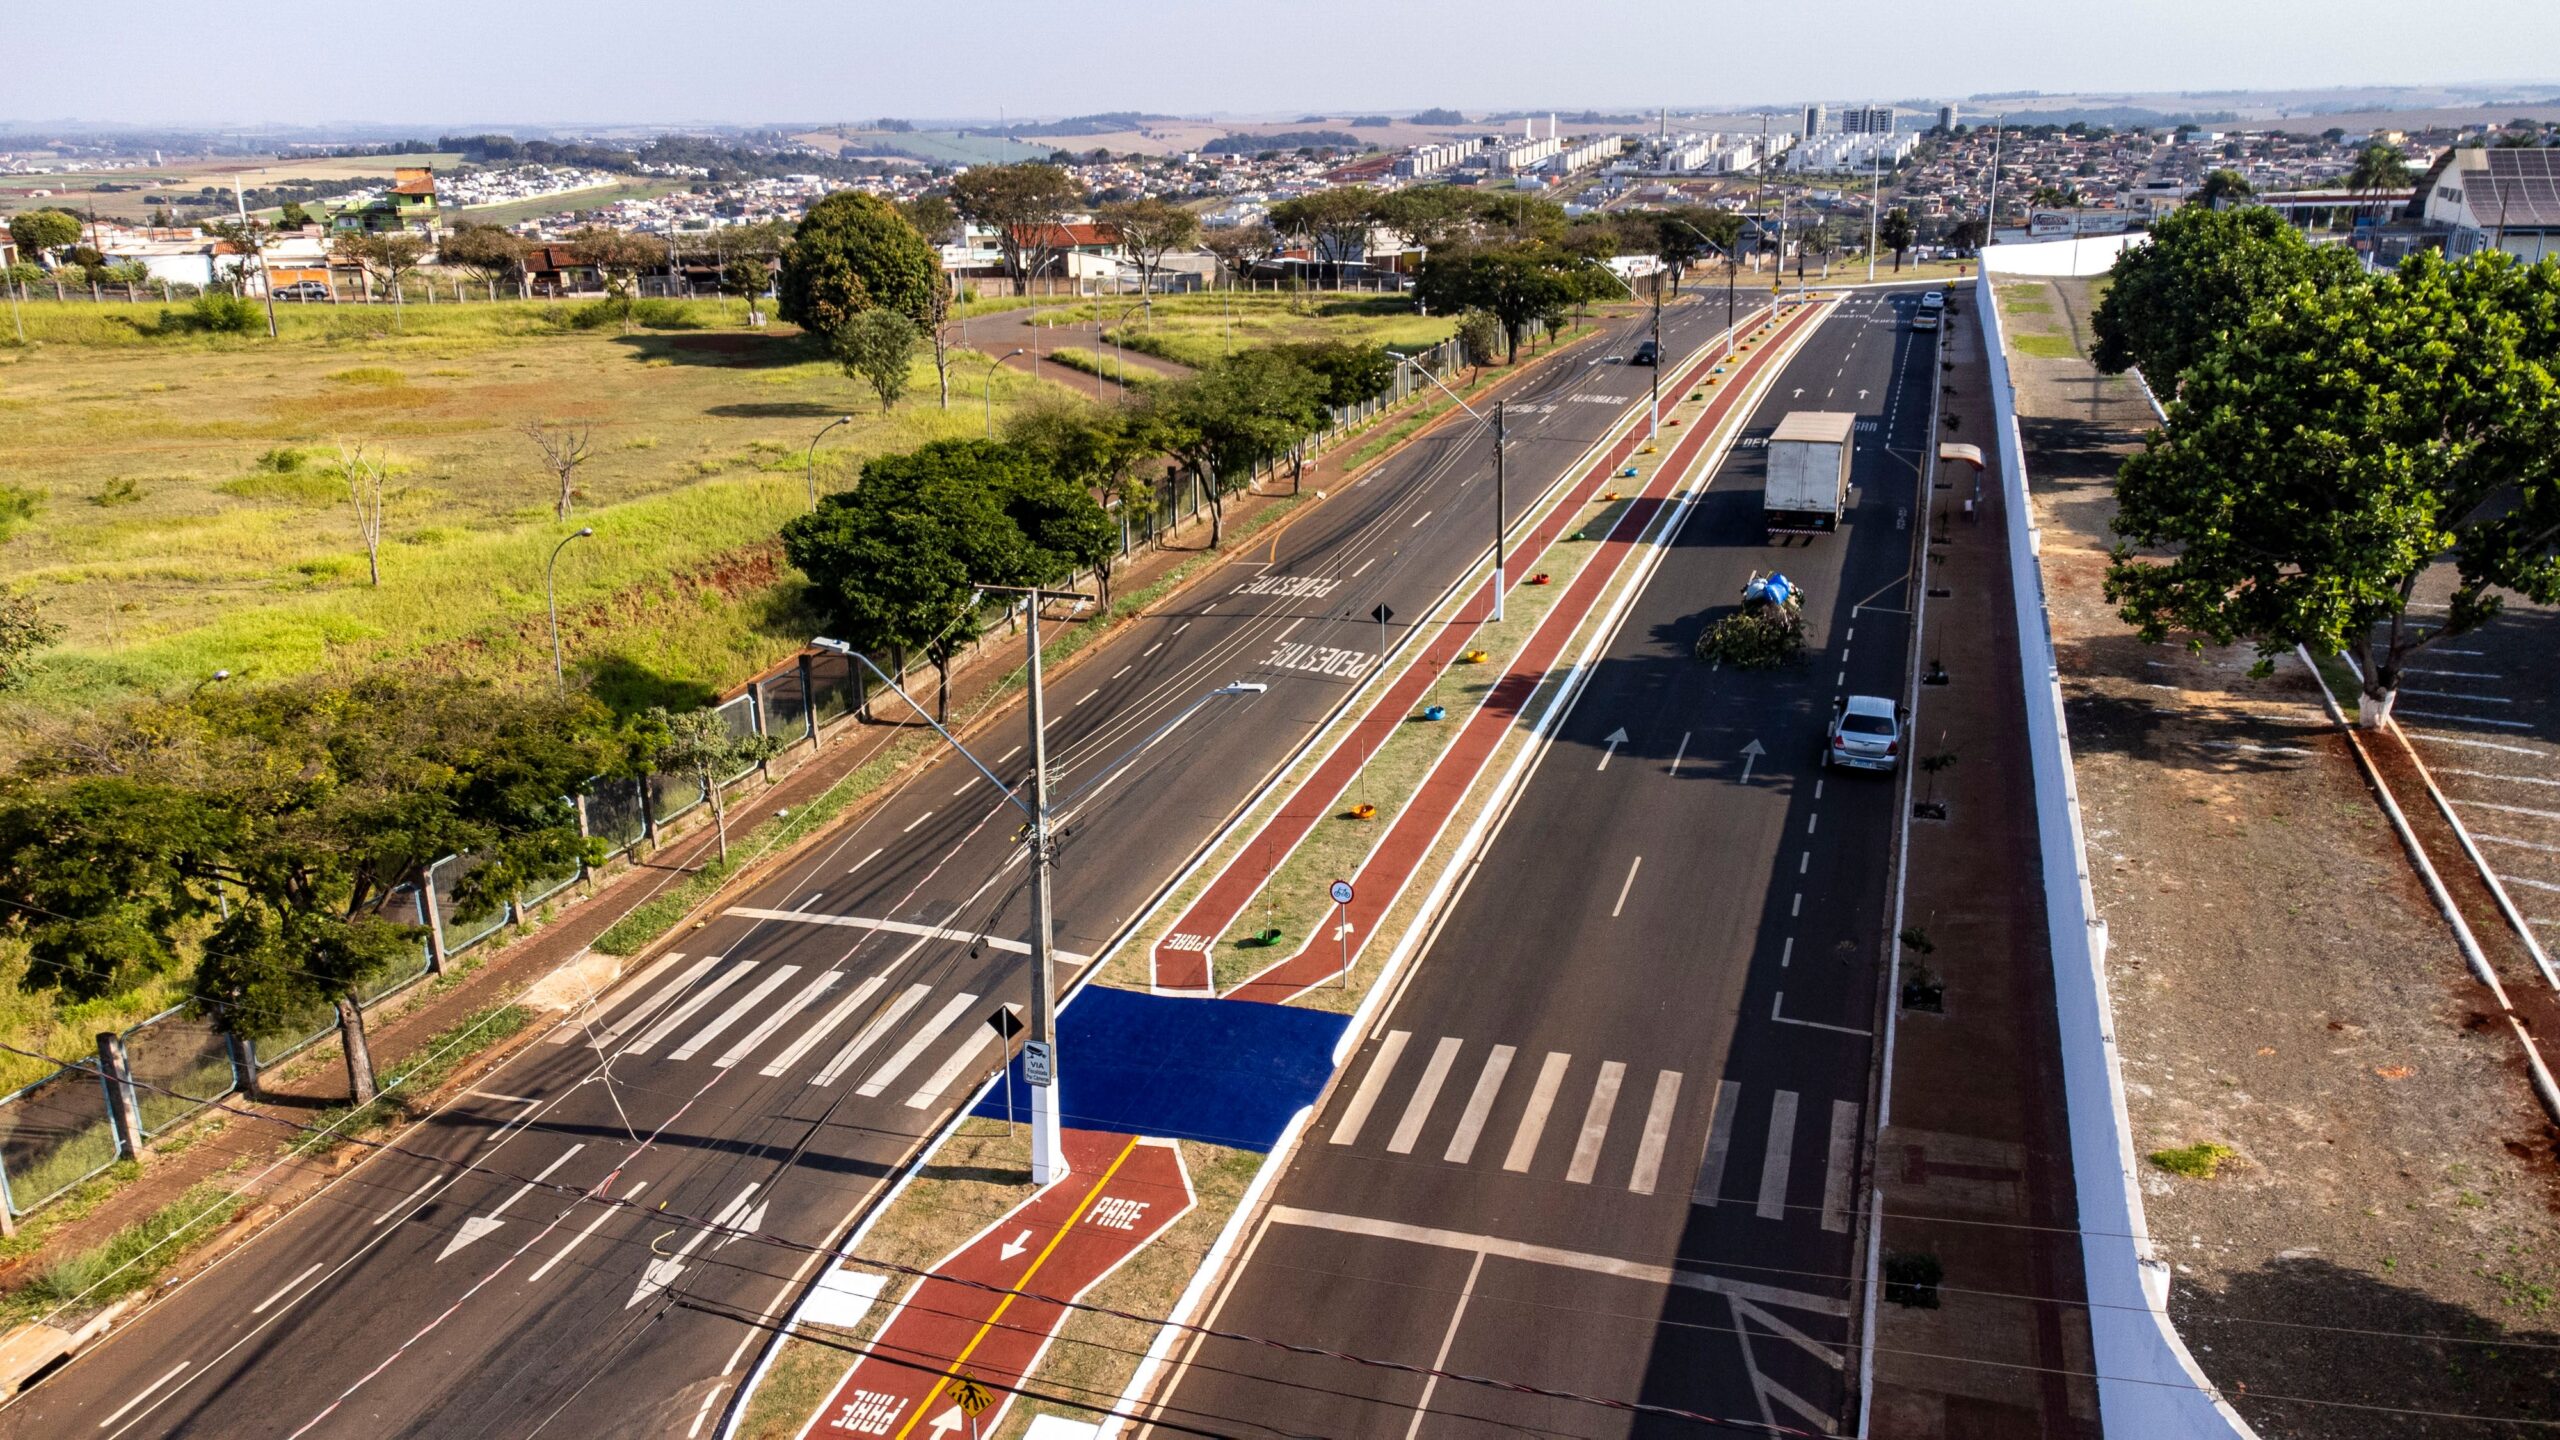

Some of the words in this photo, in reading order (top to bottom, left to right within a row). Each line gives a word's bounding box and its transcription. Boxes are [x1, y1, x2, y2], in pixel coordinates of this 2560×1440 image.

[1237, 575, 1342, 598] PEDESTRE
[1259, 641, 1377, 679] PEDESTRE
[1163, 933, 1211, 952] PARE
[1030, 1061, 1044, 1069] VIA
[1084, 1196, 1151, 1230] PARE
[830, 1389, 909, 1436] PARE
